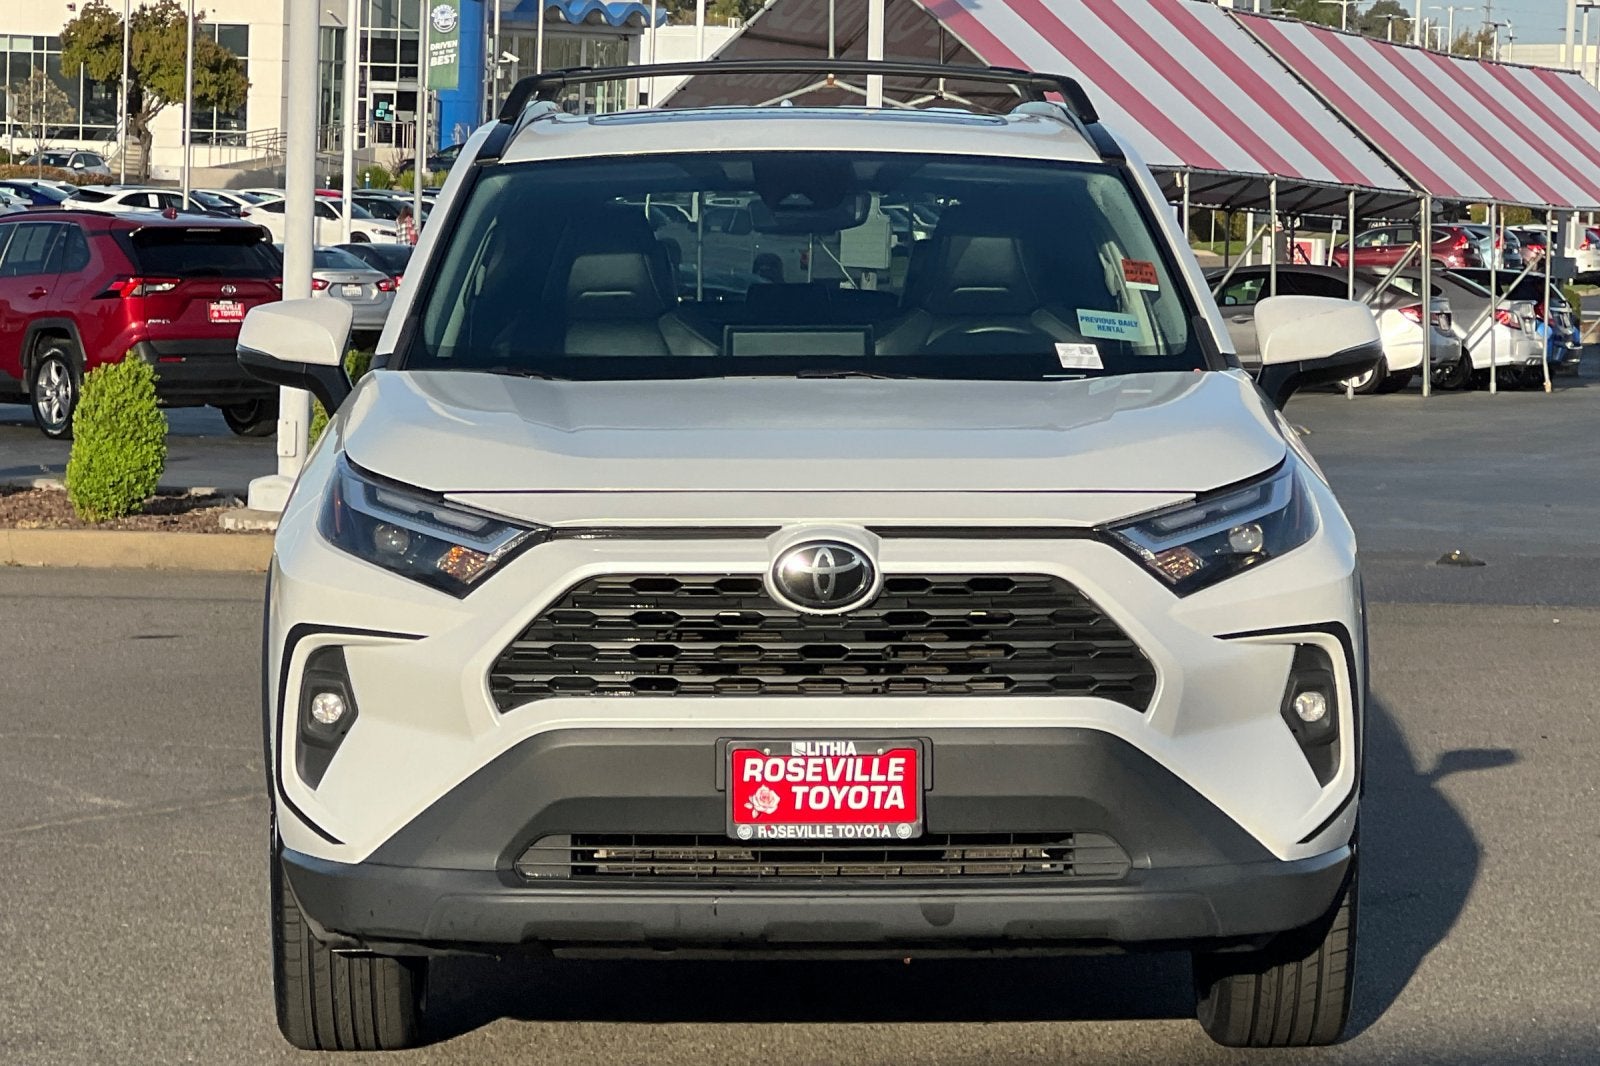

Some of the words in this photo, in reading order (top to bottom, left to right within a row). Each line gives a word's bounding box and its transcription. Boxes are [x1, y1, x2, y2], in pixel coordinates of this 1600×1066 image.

[430, 40, 458, 50] DRIVEN
[430, 54, 456, 66] BEST
[1080, 315, 1117, 325] PREVIOUS
[1118, 318, 1138, 328] DAILY
[1097, 324, 1125, 333] RENTAL
[806, 741, 857, 756] LITHIA
[743, 757, 906, 782] ROSEVILLE
[791, 785, 905, 810] TOYOTA
